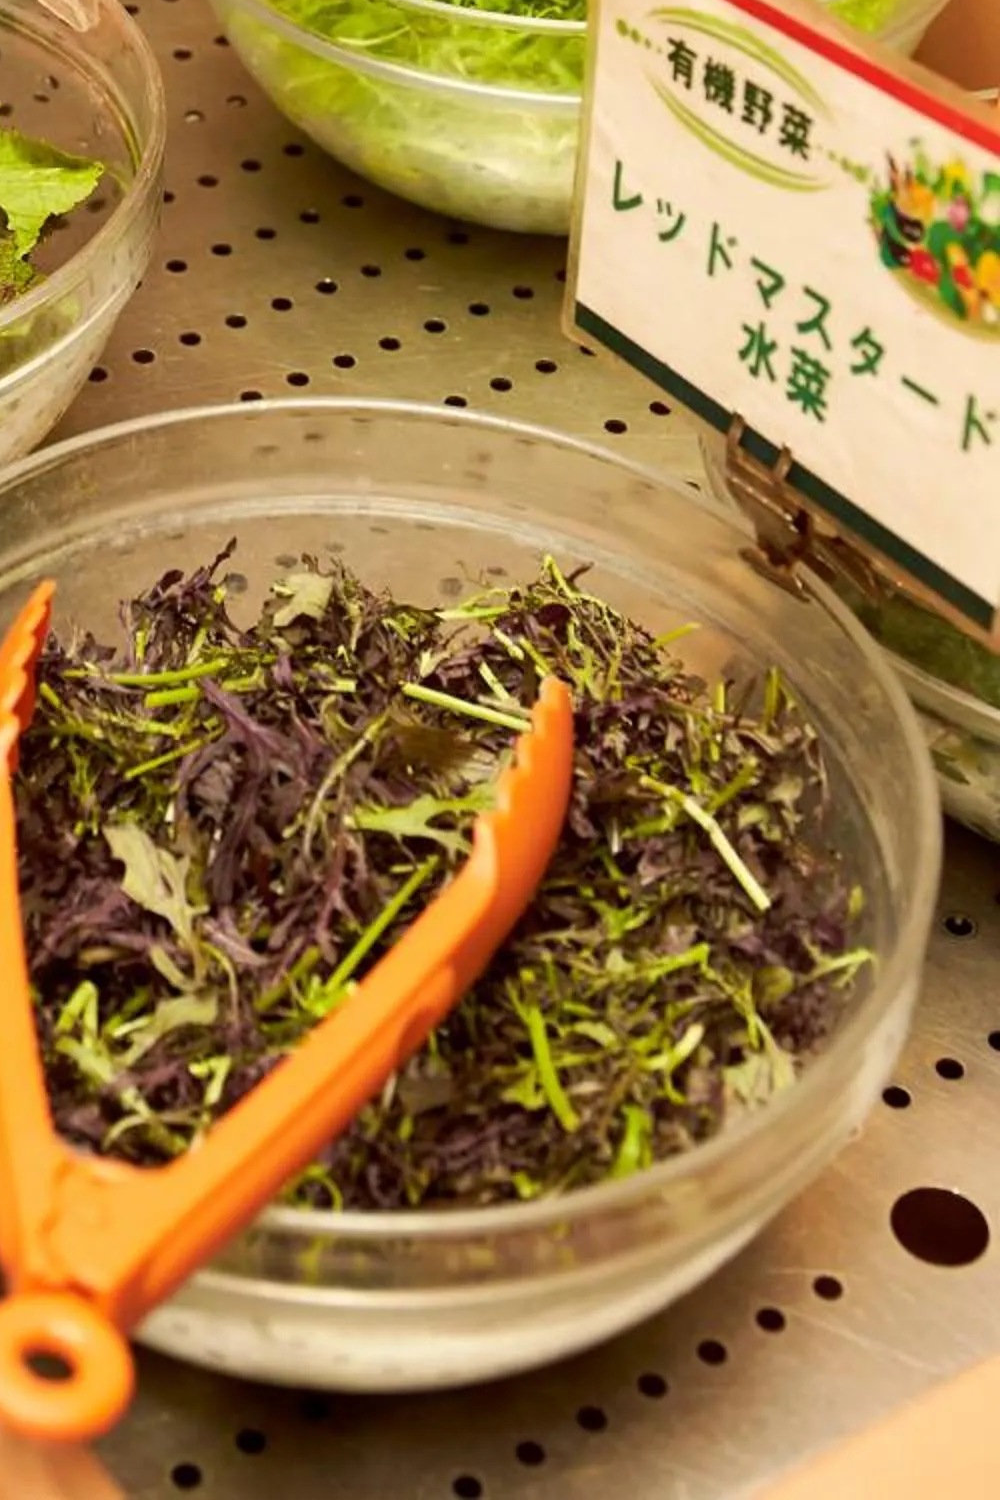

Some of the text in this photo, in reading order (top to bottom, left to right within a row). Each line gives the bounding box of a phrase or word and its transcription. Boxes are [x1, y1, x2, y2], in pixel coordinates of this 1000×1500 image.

[666, 39, 814, 160] 有機野菜
[612, 161, 998, 452] レッドマスタード
[738, 322, 830, 423] 水菜
